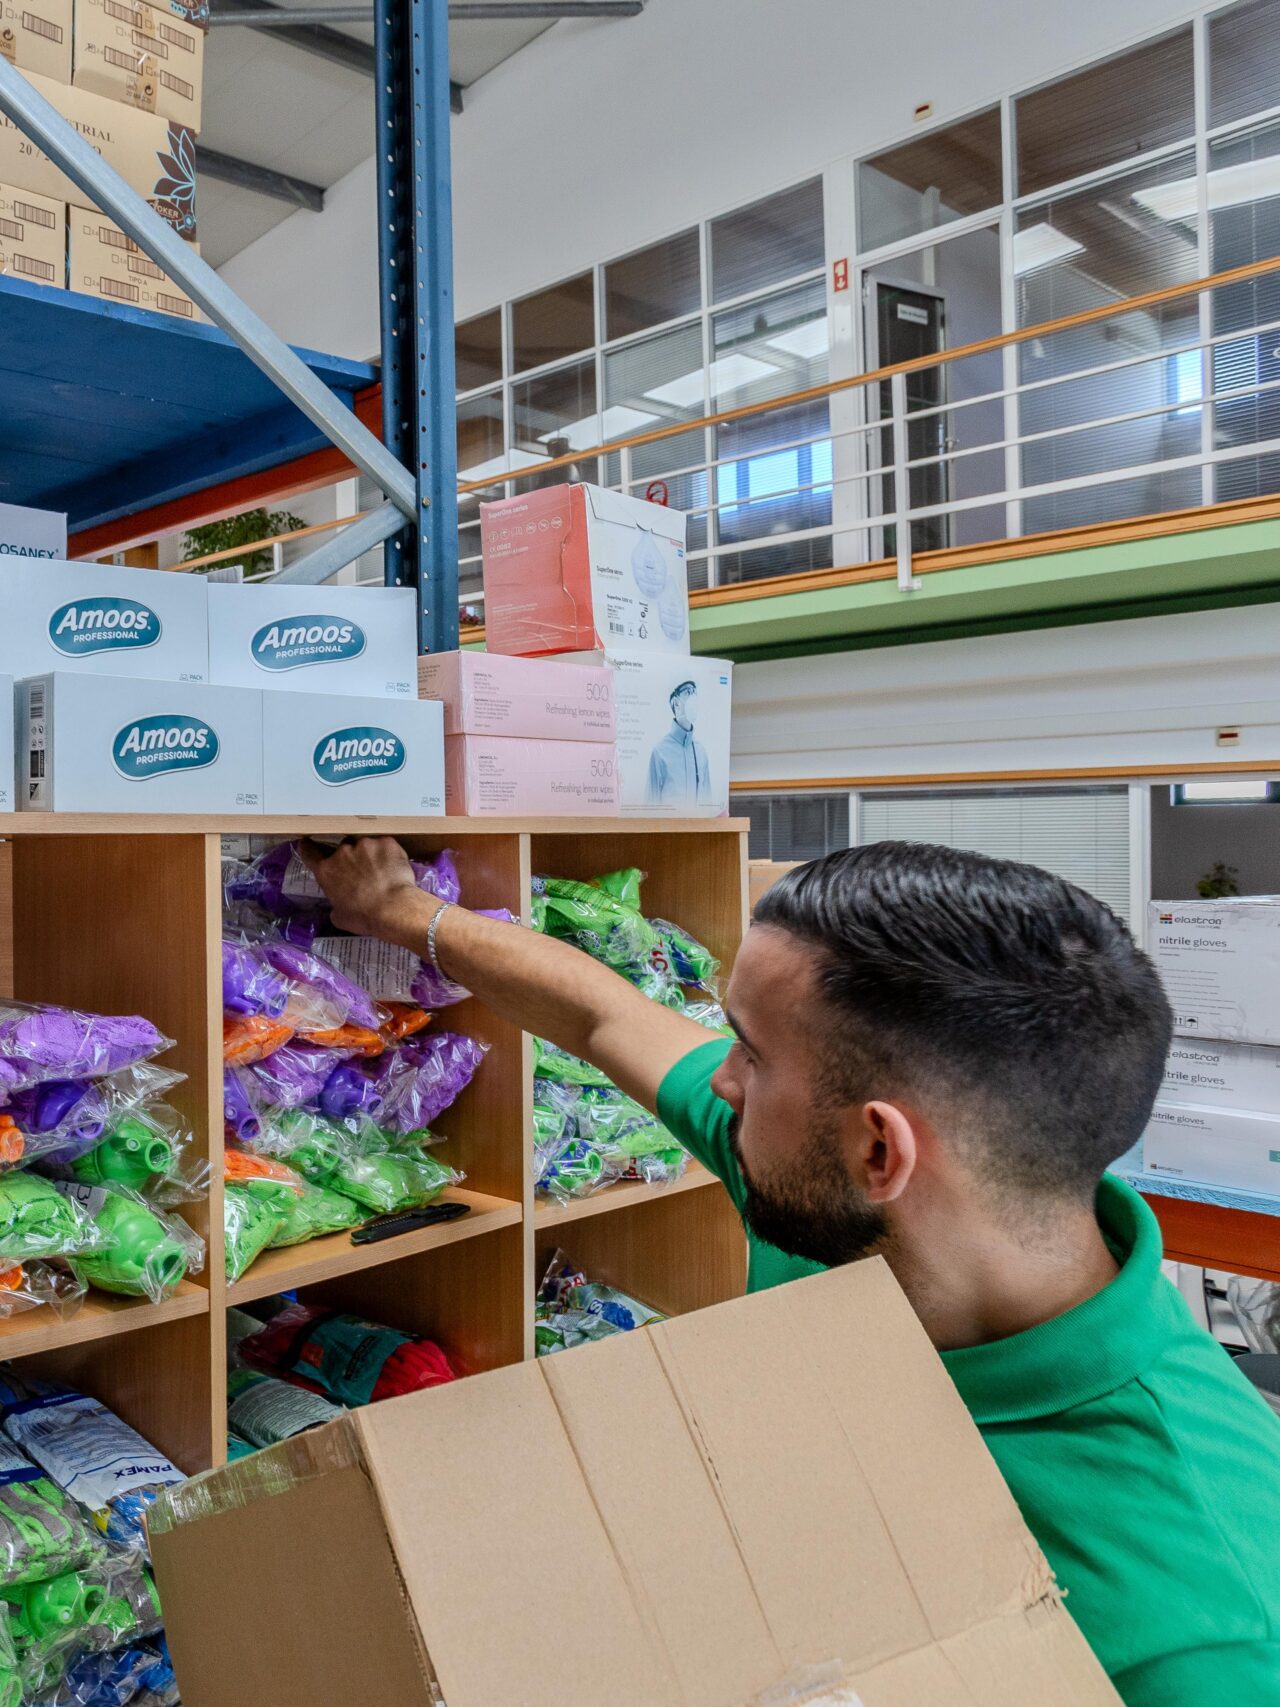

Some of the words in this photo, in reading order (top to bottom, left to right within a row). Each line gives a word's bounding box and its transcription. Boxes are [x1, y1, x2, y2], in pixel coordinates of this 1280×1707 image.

[64, 118, 115, 143] TRIAL
[19, 142, 32, 155] 20
[73, 631, 140, 643] PROFESSIONAL
[275, 645, 343, 659] PROFESSIONAL
[586, 682, 609, 701] 500
[136, 750, 199, 765] PROFESSIONAL
[333, 758, 388, 773] PROFESSIONAL
[590, 759, 613, 777] 500
[1174, 915, 1222, 925] elastron
[1159, 935, 1191, 946] nitrile
[1192, 937, 1227, 948] gloves
[1171, 1050, 1220, 1062] elastron
[1163, 1071, 1189, 1081] itrile
[1190, 1074, 1225, 1086] gloves
[1176, 1115, 1205, 1125] gloves
[112, 1463, 173, 1479] PAMEX
